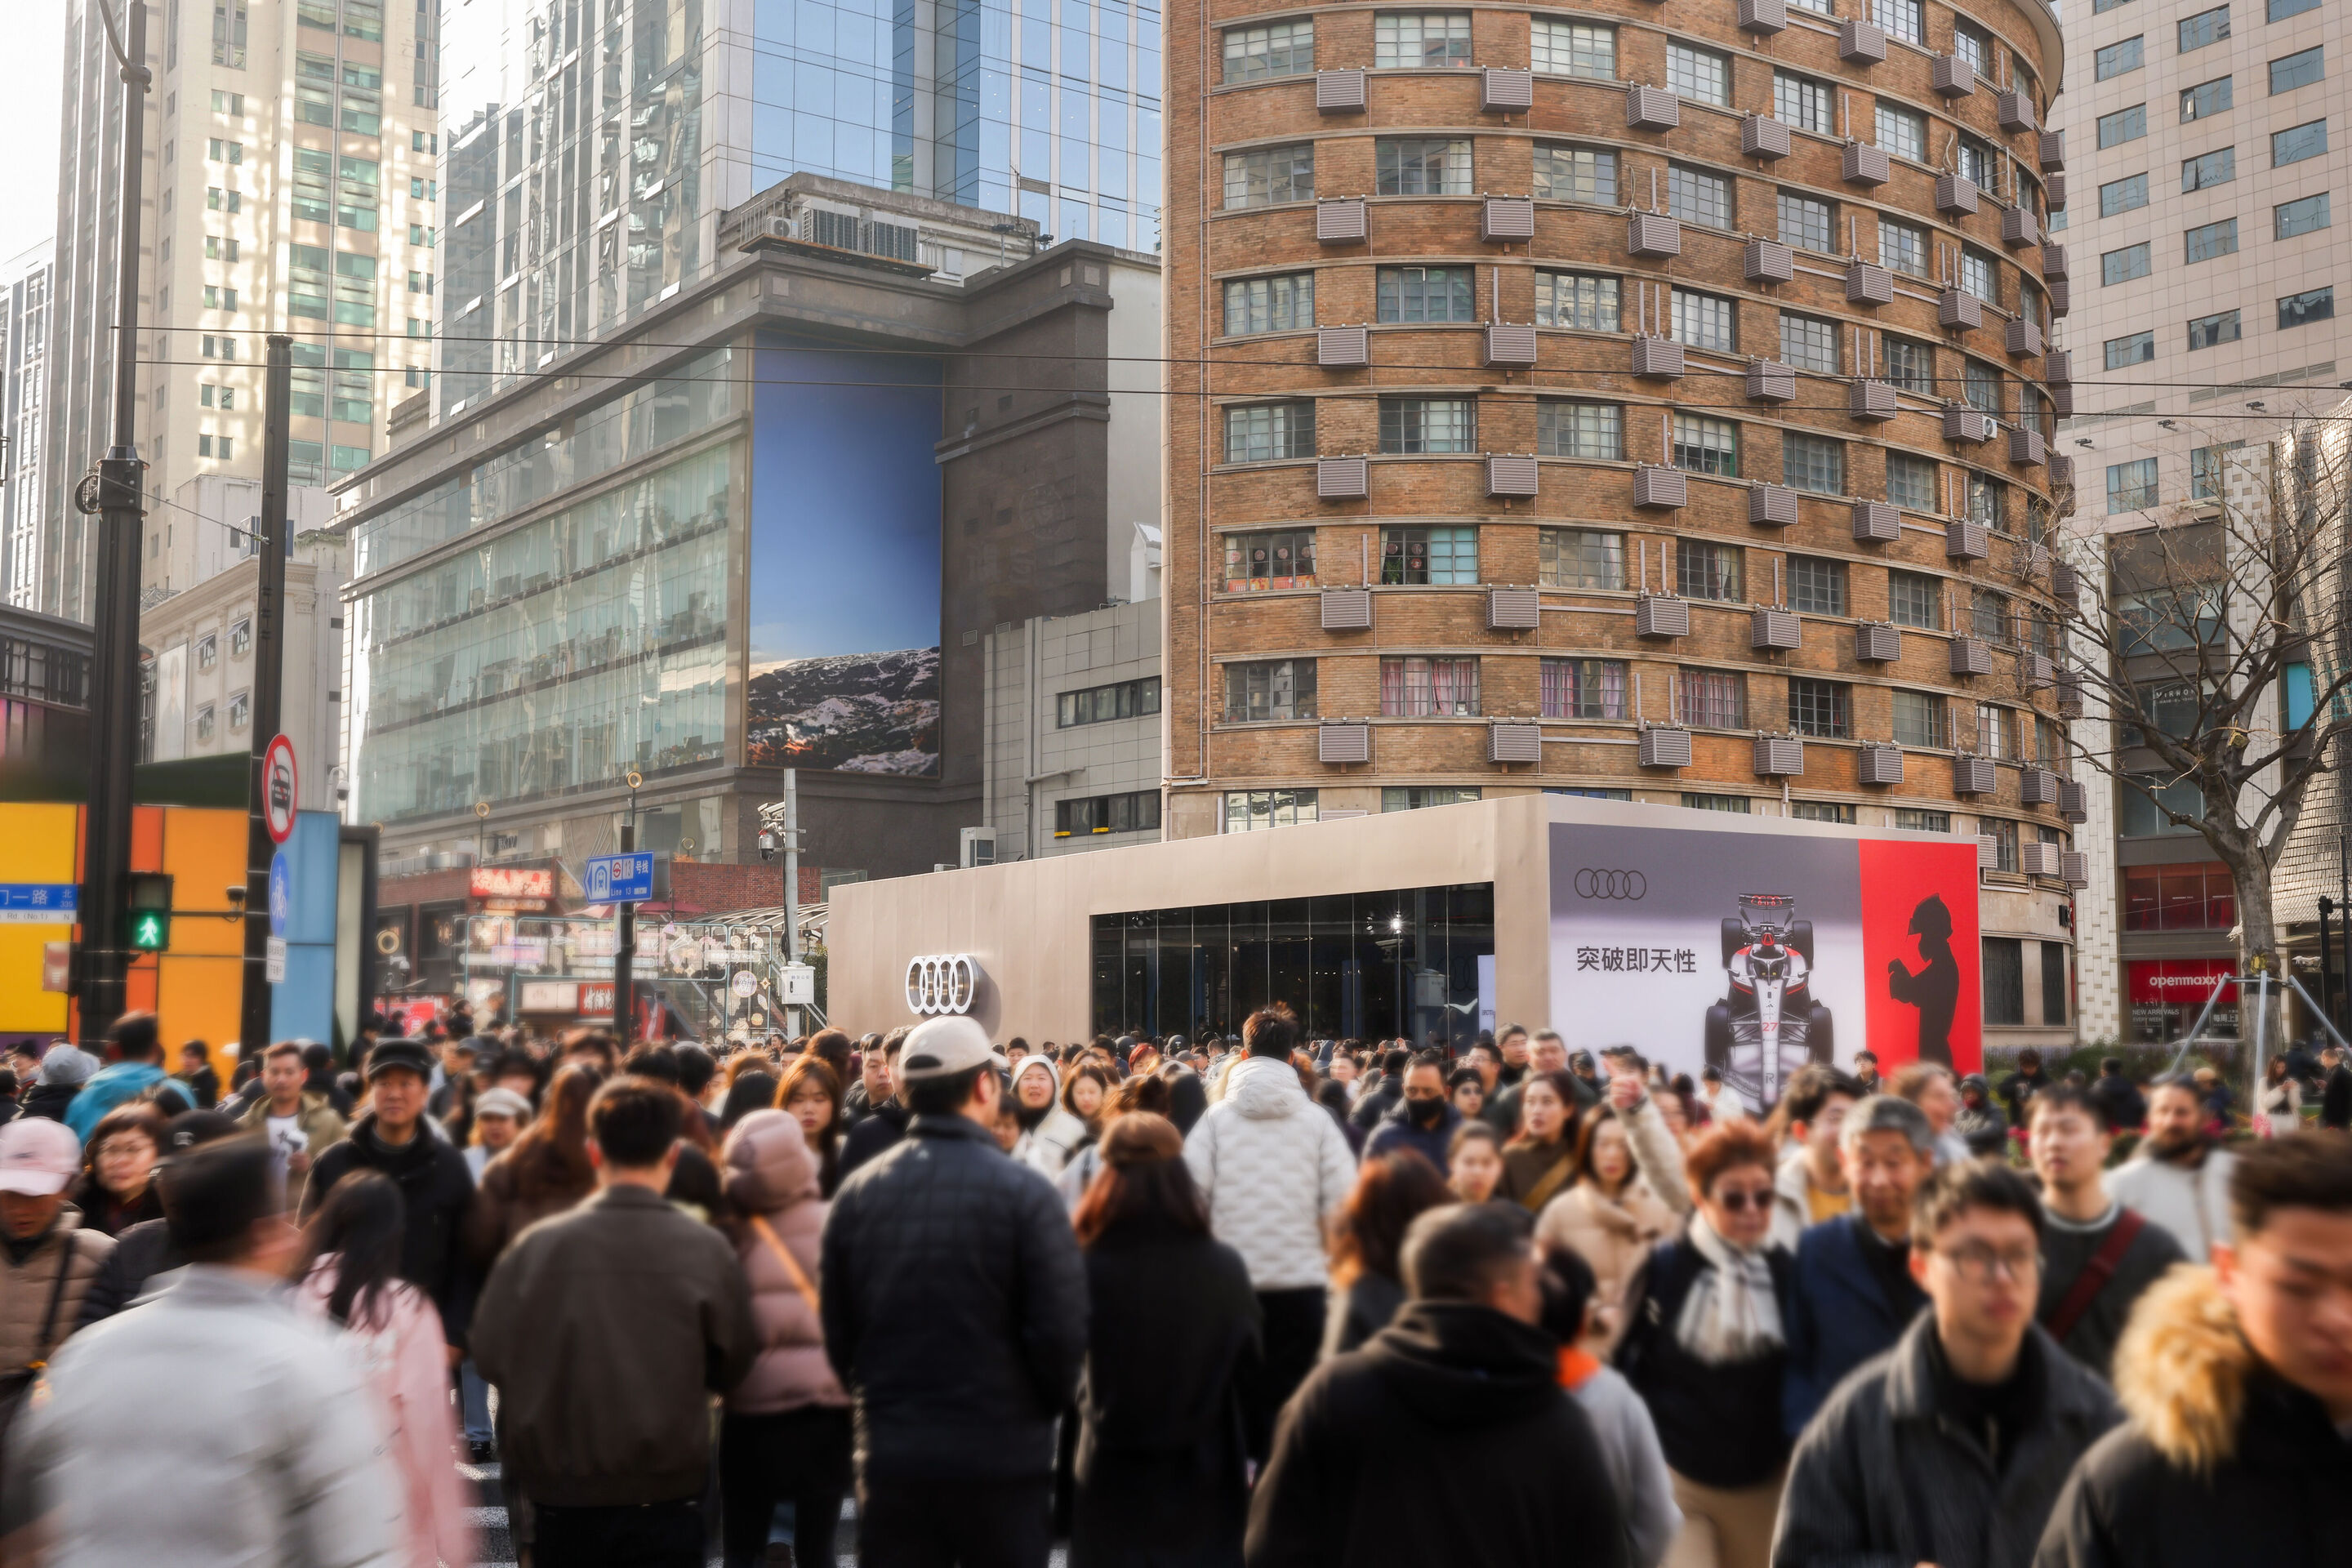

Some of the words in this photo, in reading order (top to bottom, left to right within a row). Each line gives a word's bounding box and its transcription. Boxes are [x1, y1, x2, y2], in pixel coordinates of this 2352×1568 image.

[625, 861, 631, 876] 13
[635, 860, 649, 874] 号线
[62, 889, 73, 898] 北
[611, 889, 621, 897] Line
[626, 887, 631, 895] 13
[1577, 946, 1696, 973] 突破即天性
[1762, 1022, 1778, 1031] 27
